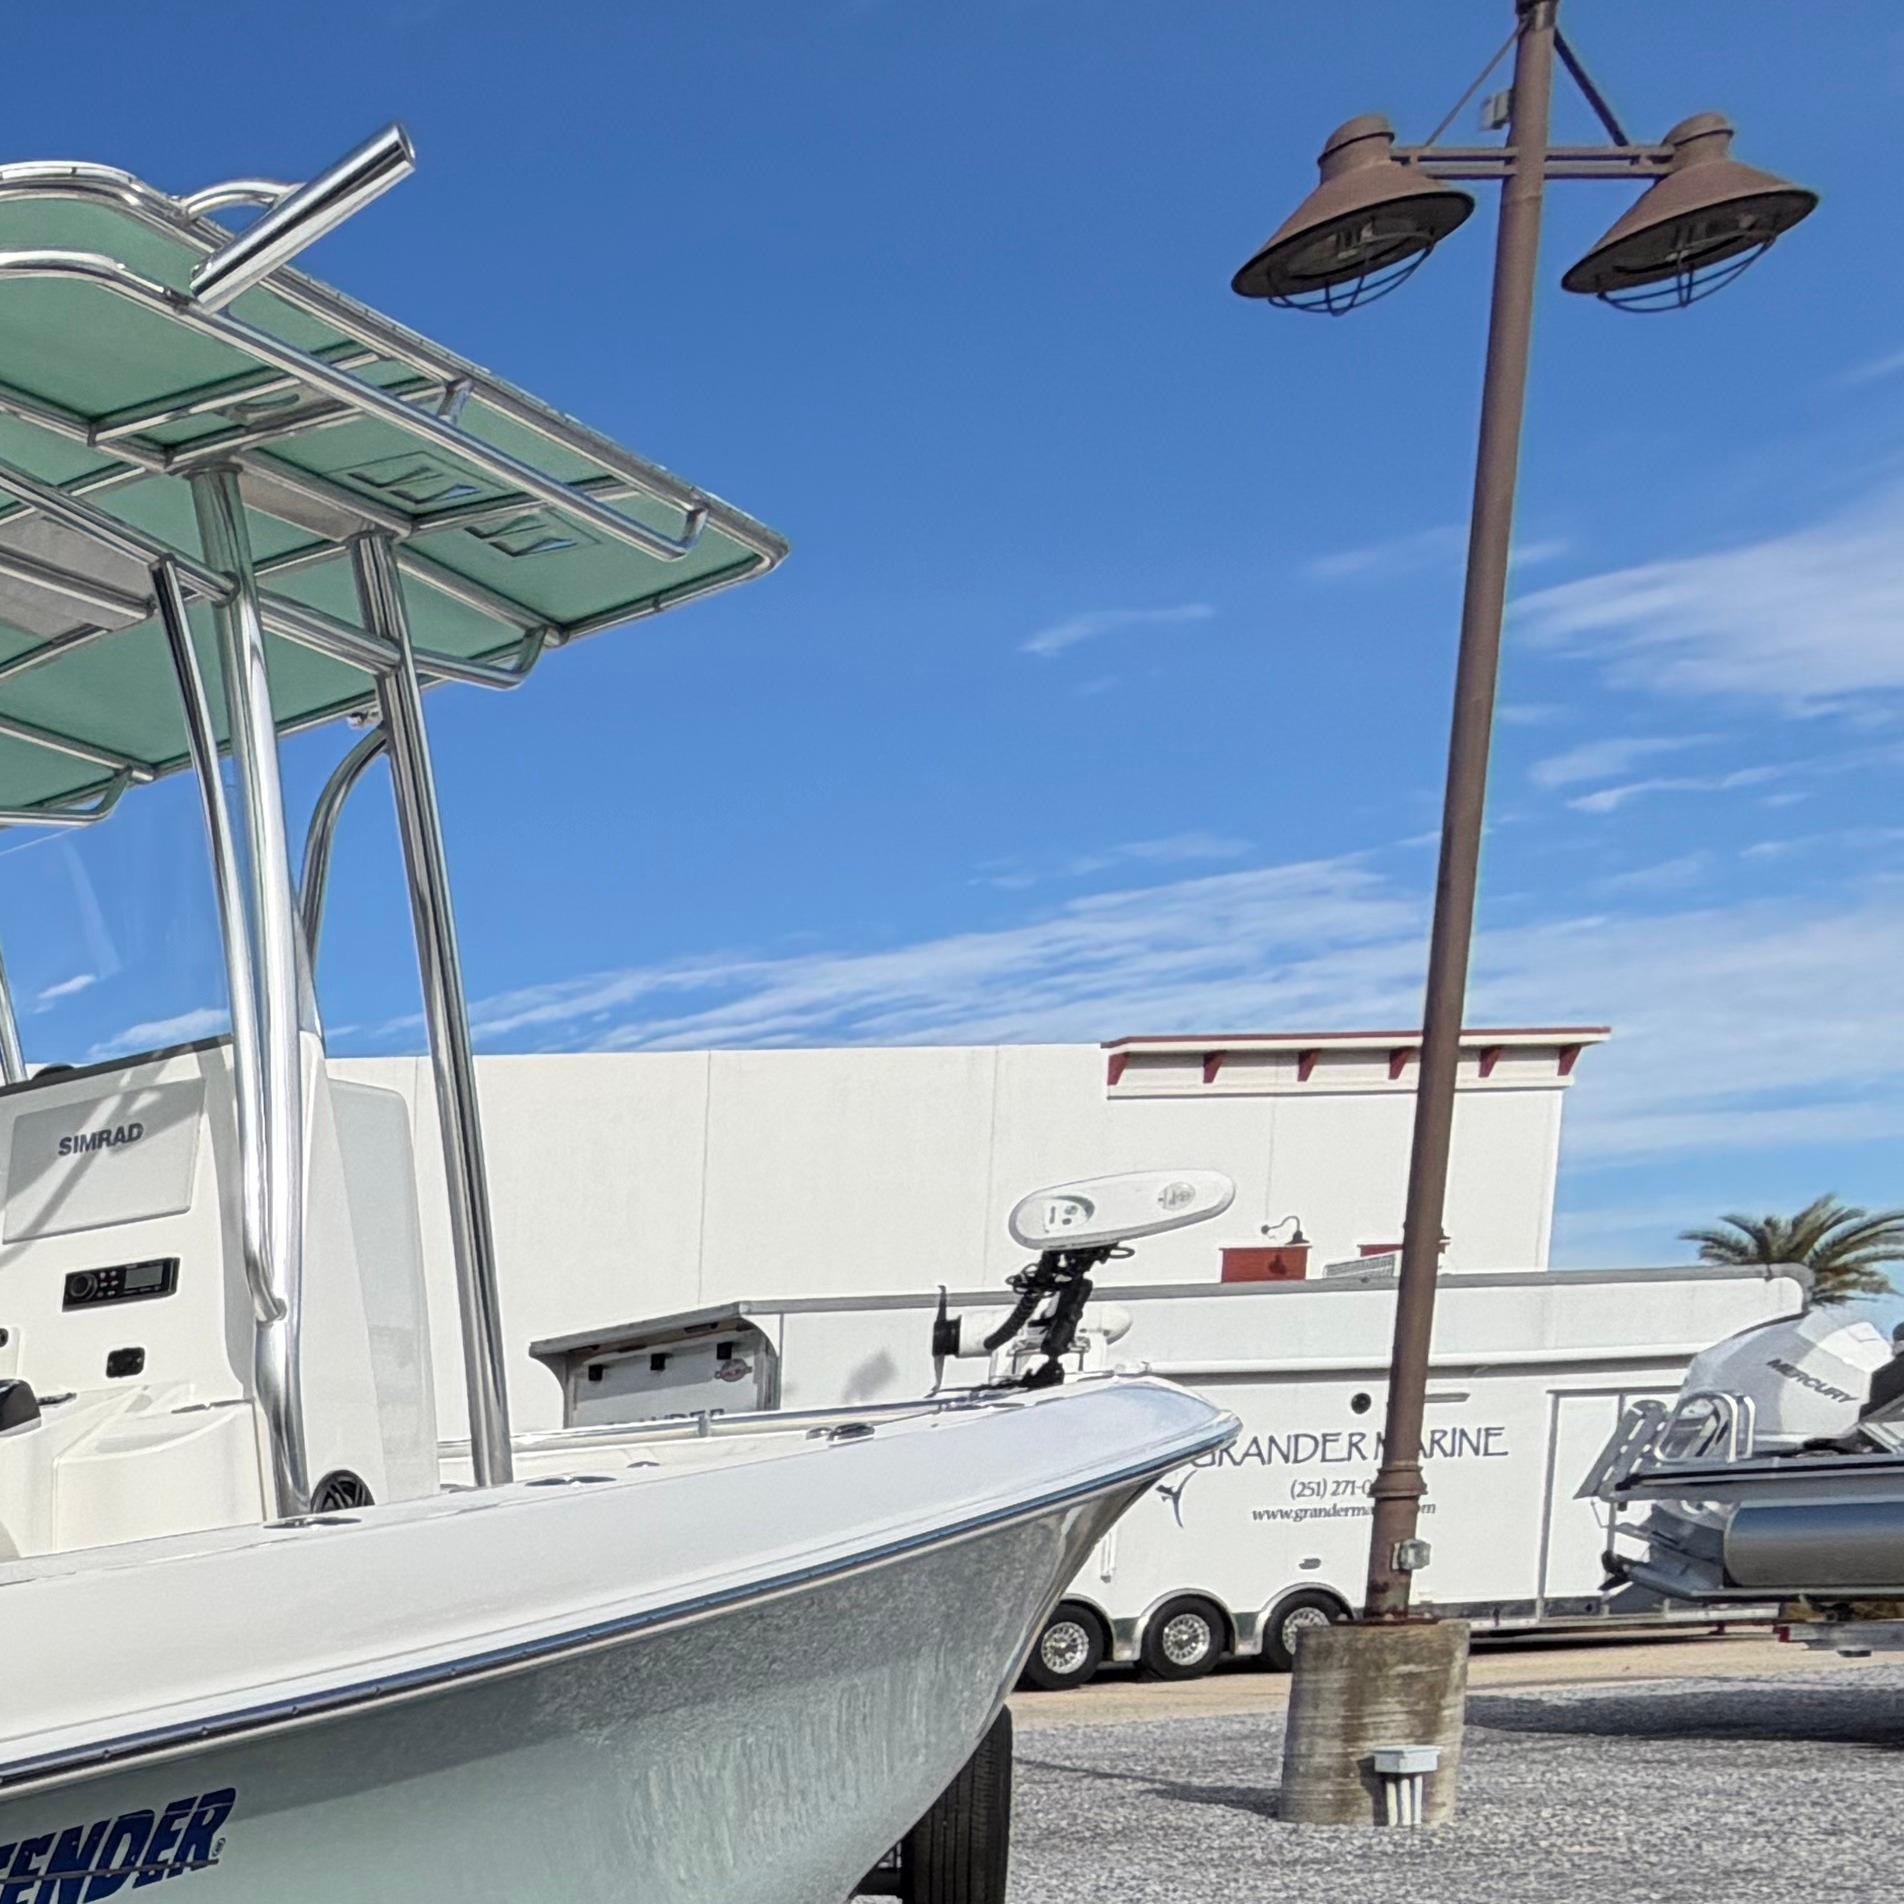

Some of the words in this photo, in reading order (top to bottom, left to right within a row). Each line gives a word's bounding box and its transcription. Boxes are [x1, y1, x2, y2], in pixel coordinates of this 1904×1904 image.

[58, 1122, 144, 1156] SIMRAD
[1766, 1358, 1859, 1404] MERCURY
[1374, 1426, 1509, 1462] RINE
[1290, 1477, 1328, 1501] (251)
[1330, 1477, 1371, 1498] 271-0
